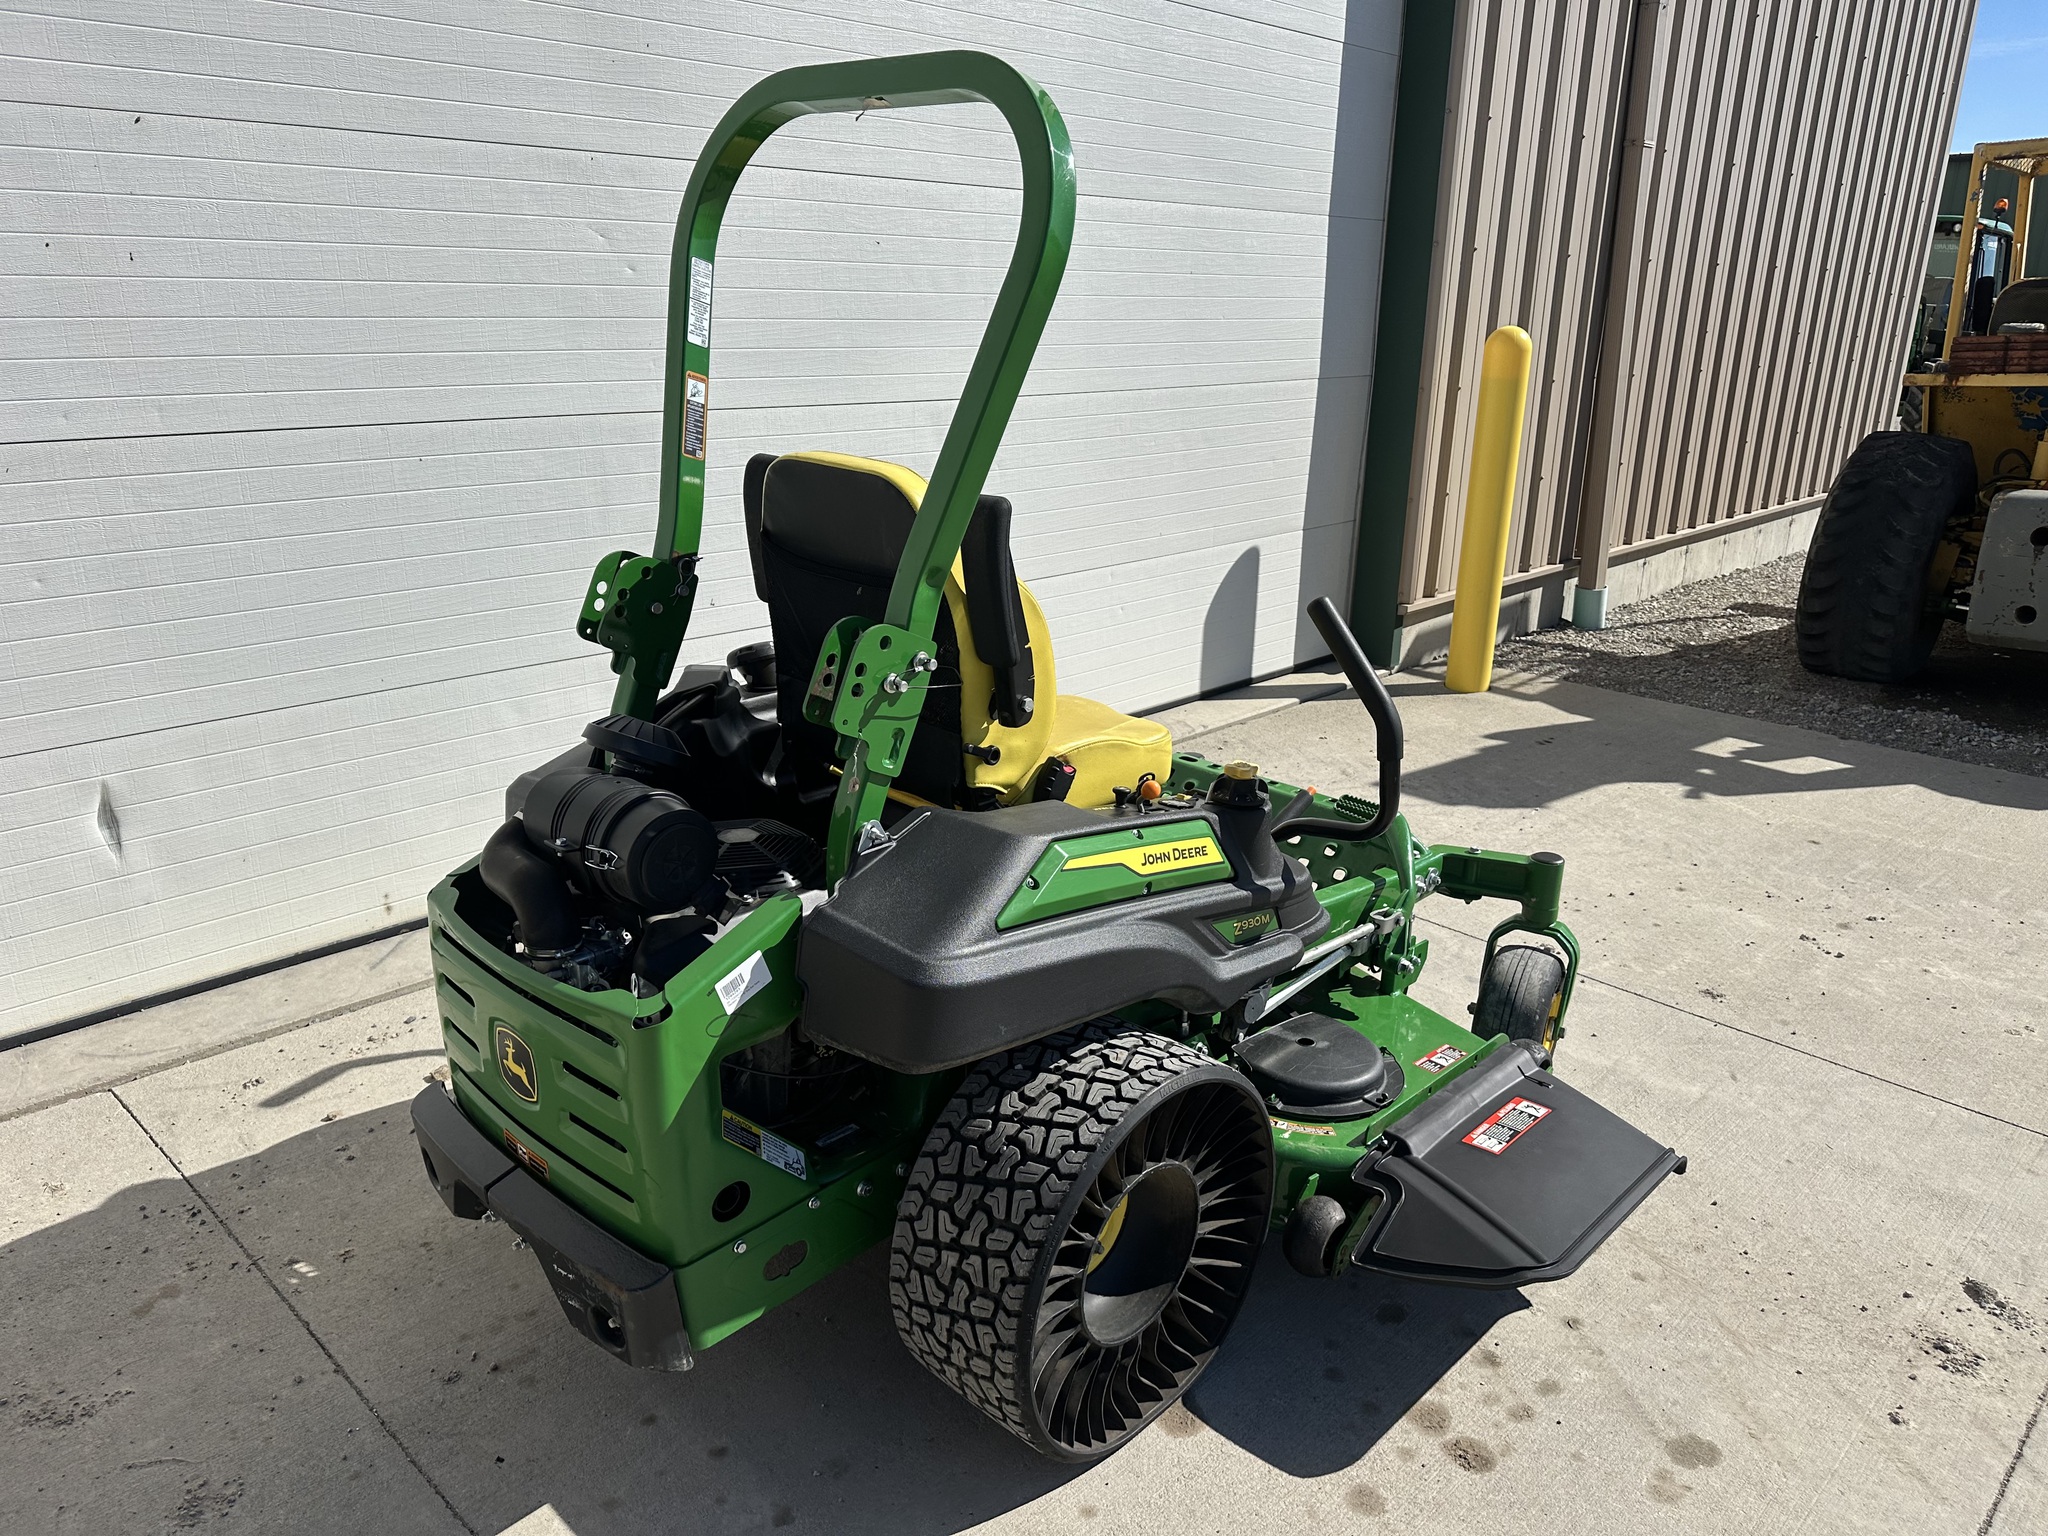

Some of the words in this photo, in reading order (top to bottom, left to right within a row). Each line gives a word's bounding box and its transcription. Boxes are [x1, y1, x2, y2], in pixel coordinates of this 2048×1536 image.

[1141, 850, 1171, 867] JOHN
[1171, 845, 1208, 861] DEERE
[1233, 913, 1270, 936] Z930M
[1159, 1071, 1203, 1099] MICHELIN
